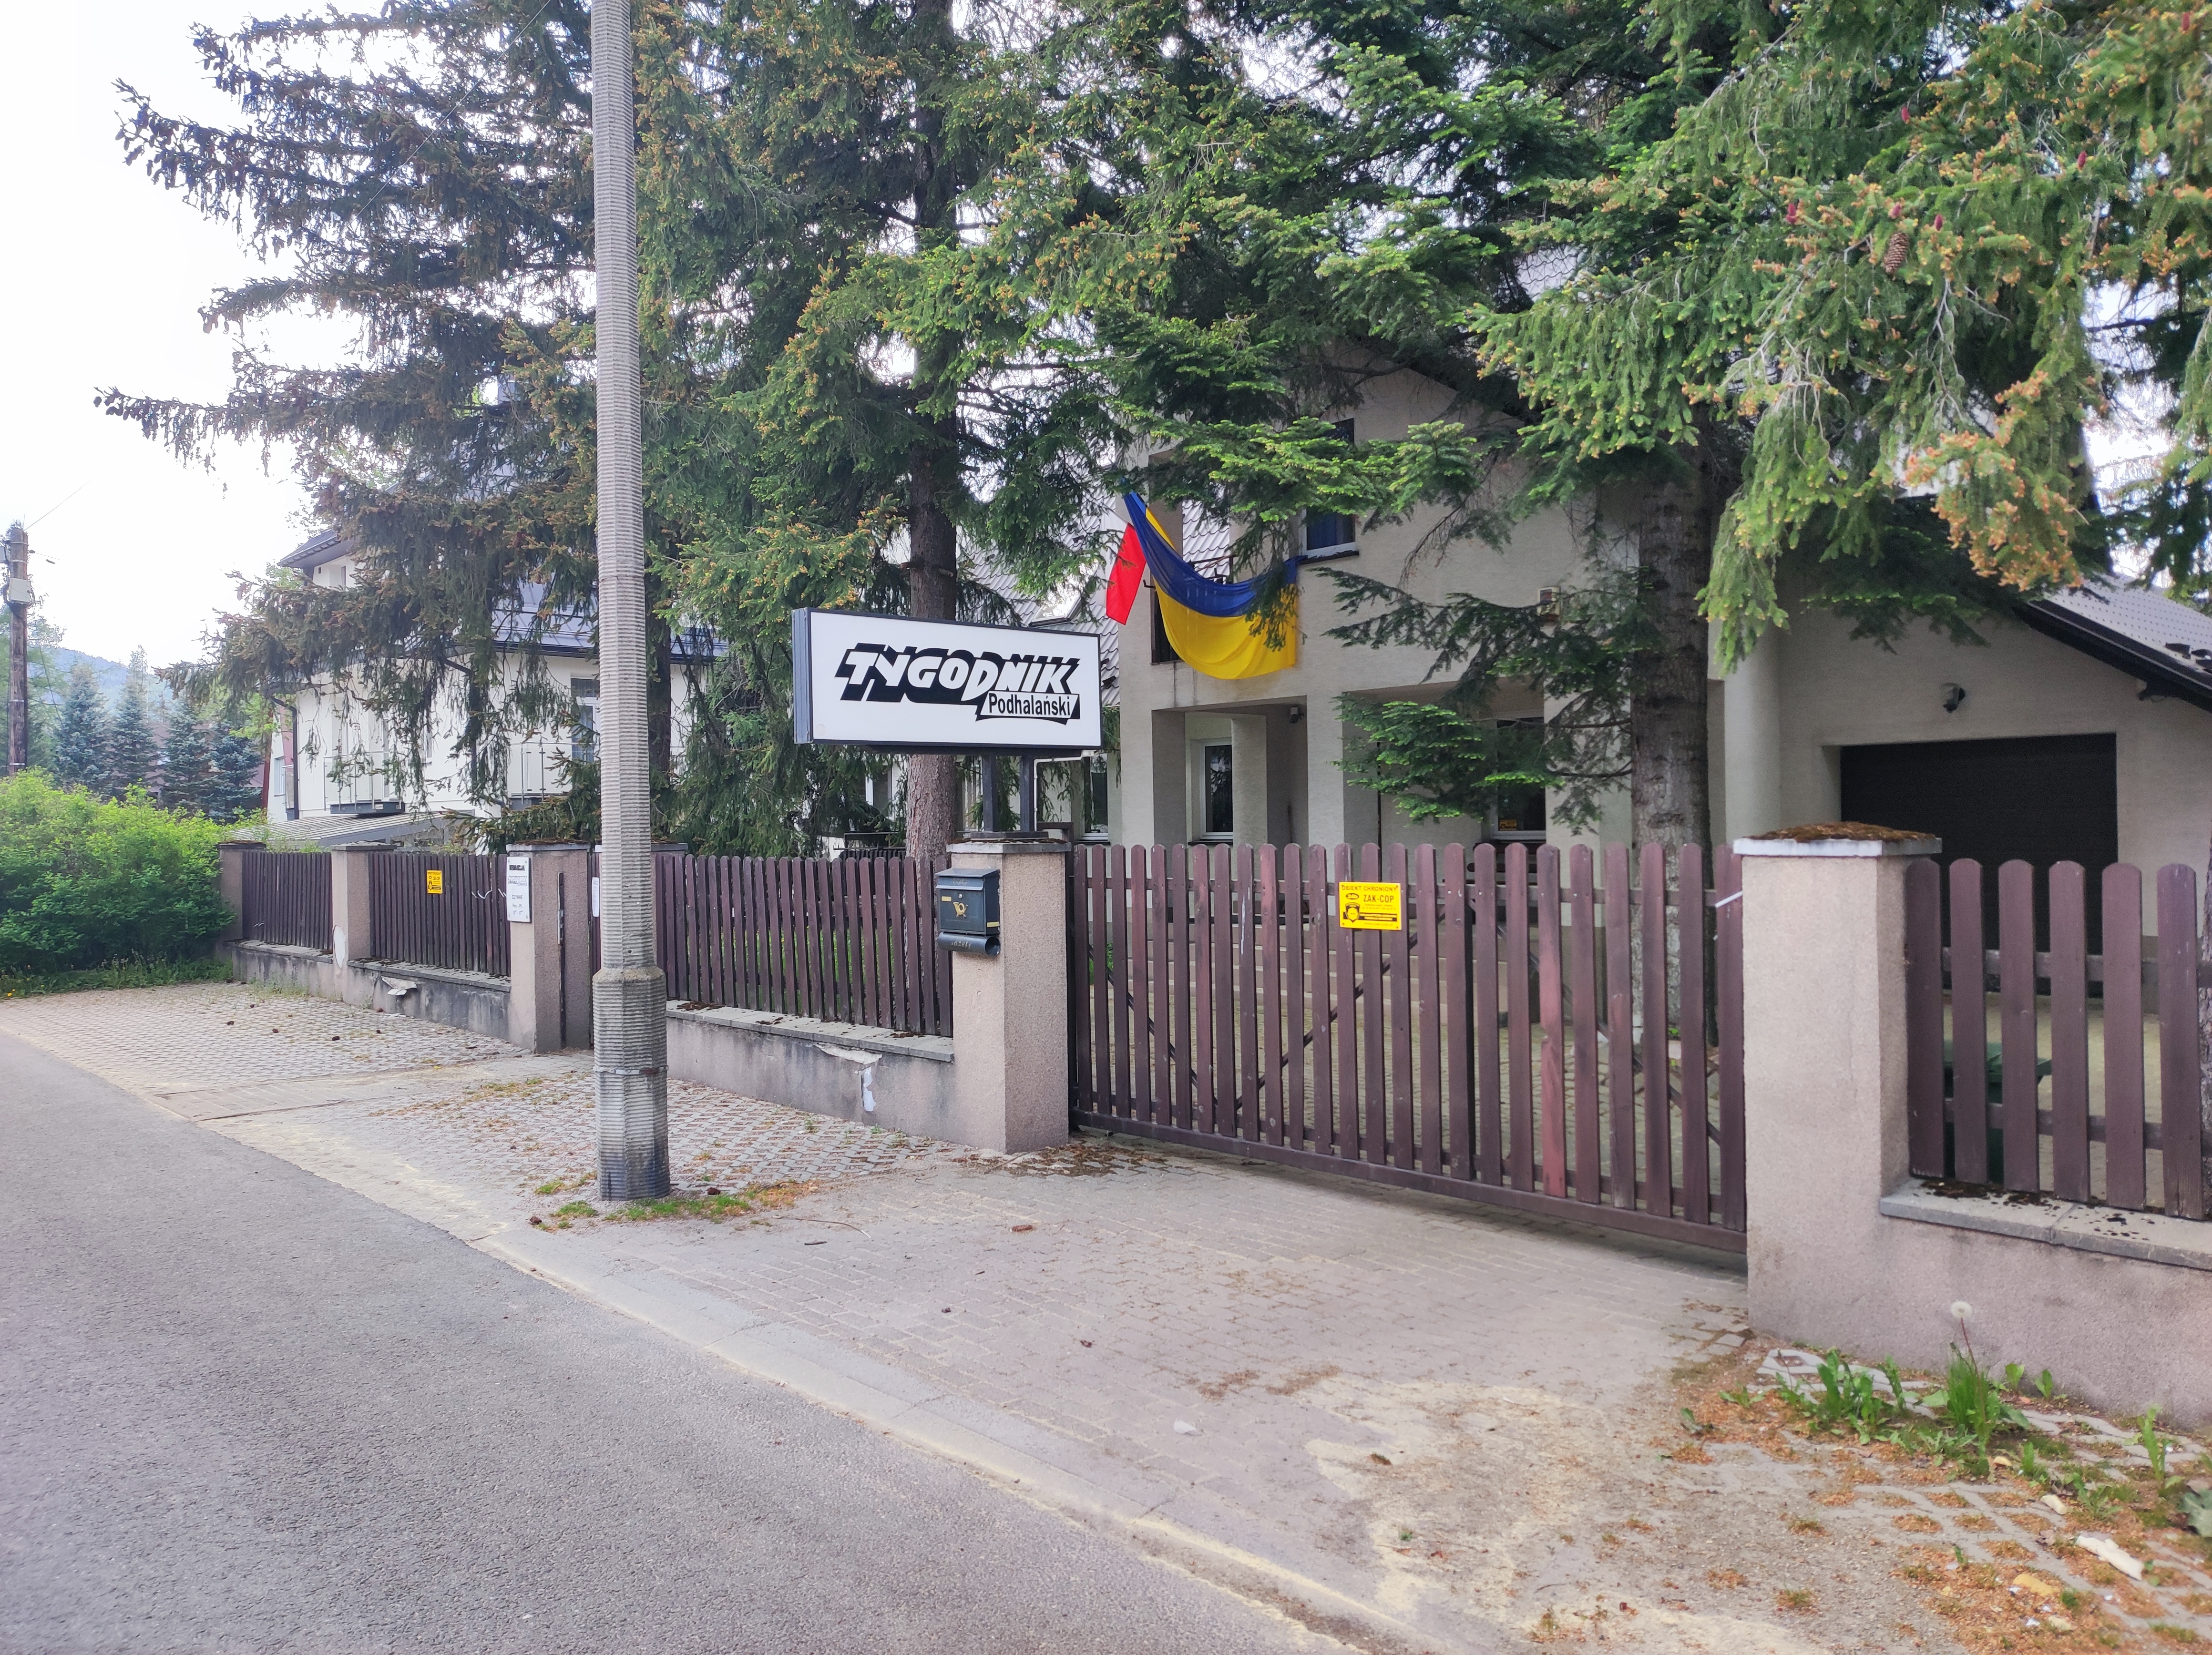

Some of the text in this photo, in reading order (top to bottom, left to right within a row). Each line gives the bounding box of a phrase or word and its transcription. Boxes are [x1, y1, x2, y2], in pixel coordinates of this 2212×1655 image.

[835, 643, 1080, 705] TYGODNIK
[989, 693, 1071, 716] Podhalański
[1363, 895, 1394, 903] ZAK-COP
